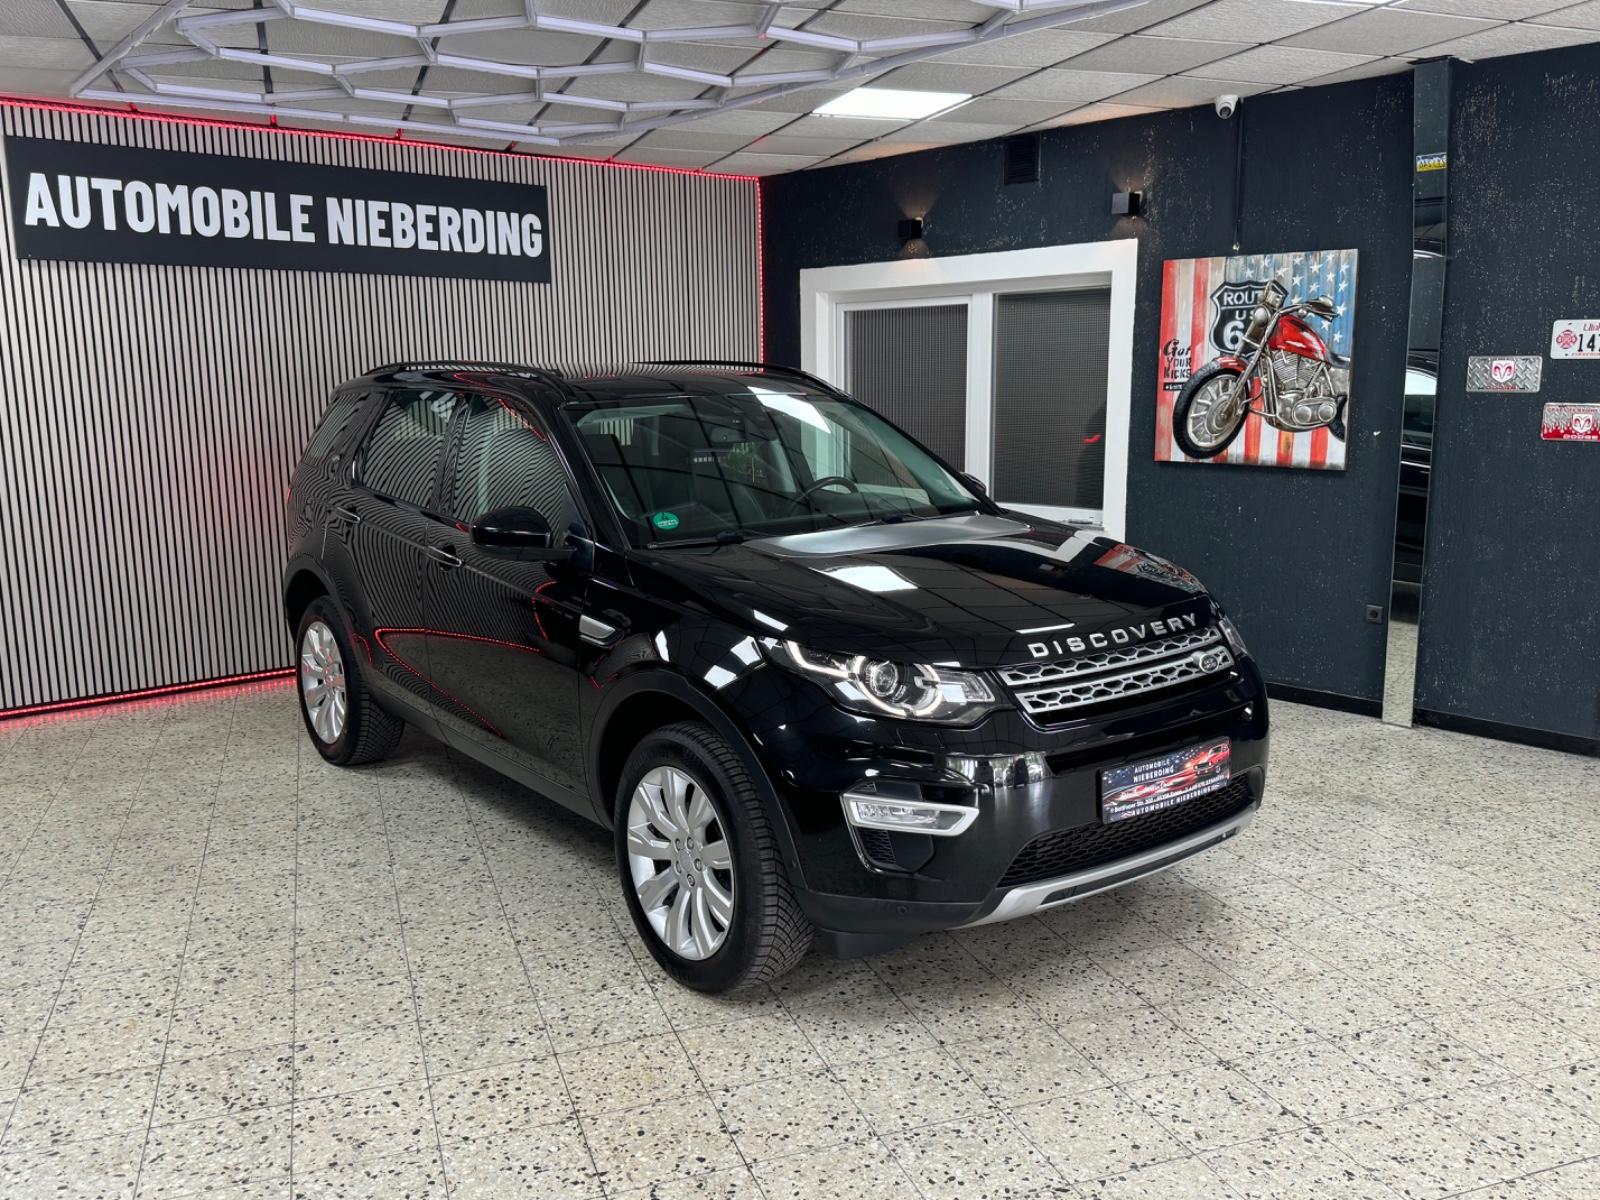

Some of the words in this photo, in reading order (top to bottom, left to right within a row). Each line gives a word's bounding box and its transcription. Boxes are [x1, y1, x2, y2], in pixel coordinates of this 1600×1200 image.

[25, 172, 316, 243] AUTOMOBILE
[326, 196, 543, 258] NIEBERDING
[1223, 290, 1264, 305] ROUT
[1223, 320, 1245, 351] 6
[1027, 612, 1196, 658] DISCOVERY
[1133, 765, 1174, 783] NIEBERDING
[1134, 758, 1170, 774] AUTOMOBILE
[1131, 796, 1174, 816] AUTOMOBILE
